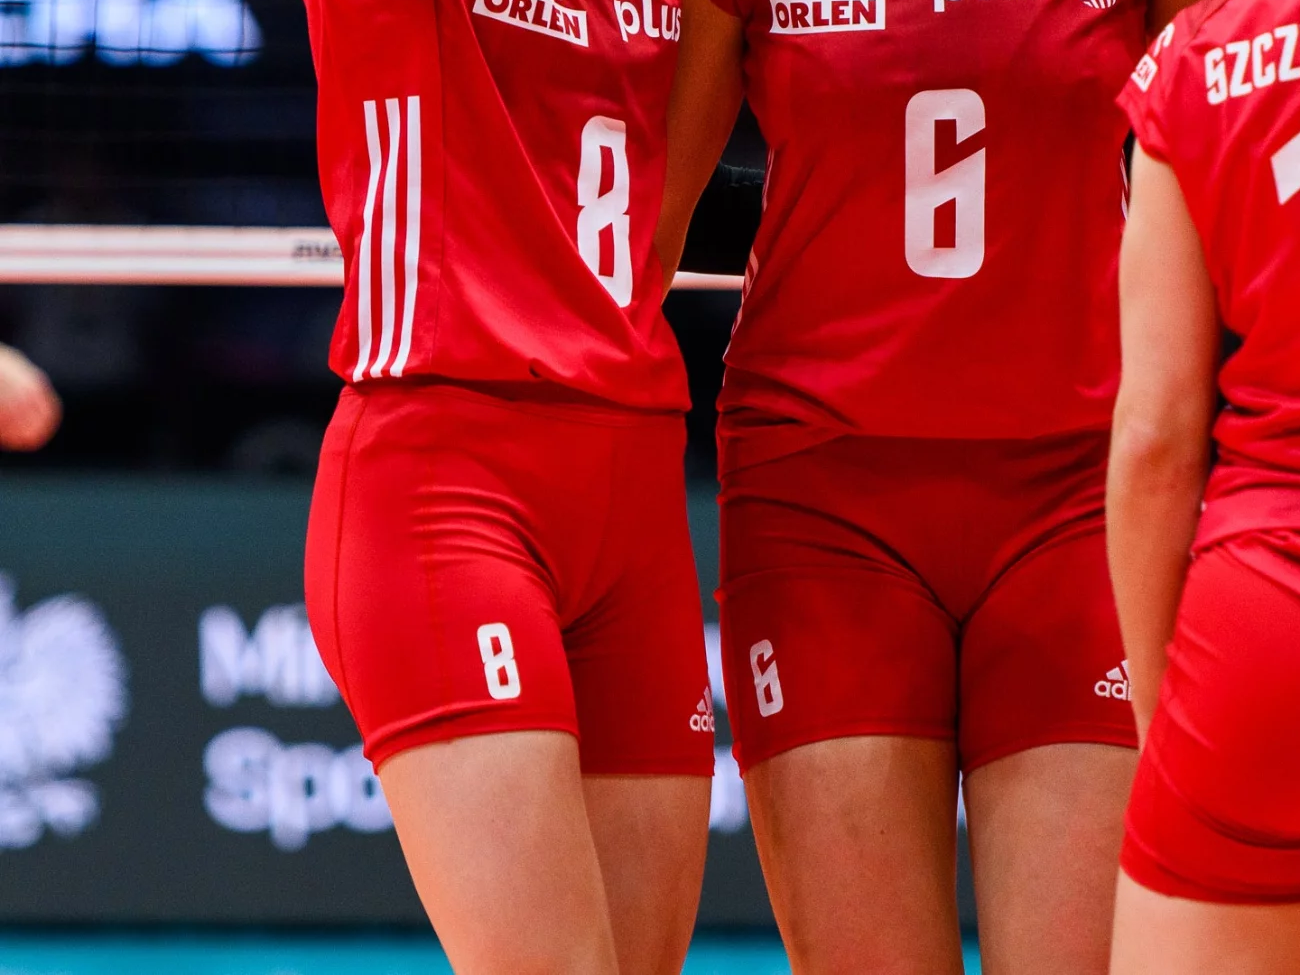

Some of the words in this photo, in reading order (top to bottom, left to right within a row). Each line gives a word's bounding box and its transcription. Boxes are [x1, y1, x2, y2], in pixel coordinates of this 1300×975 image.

[774, 0, 877, 29] ORLEN
[577, 115, 633, 308] 8
[905, 88, 986, 279] 6
[476, 622, 522, 700] 8
[750, 639, 784, 717] 6
